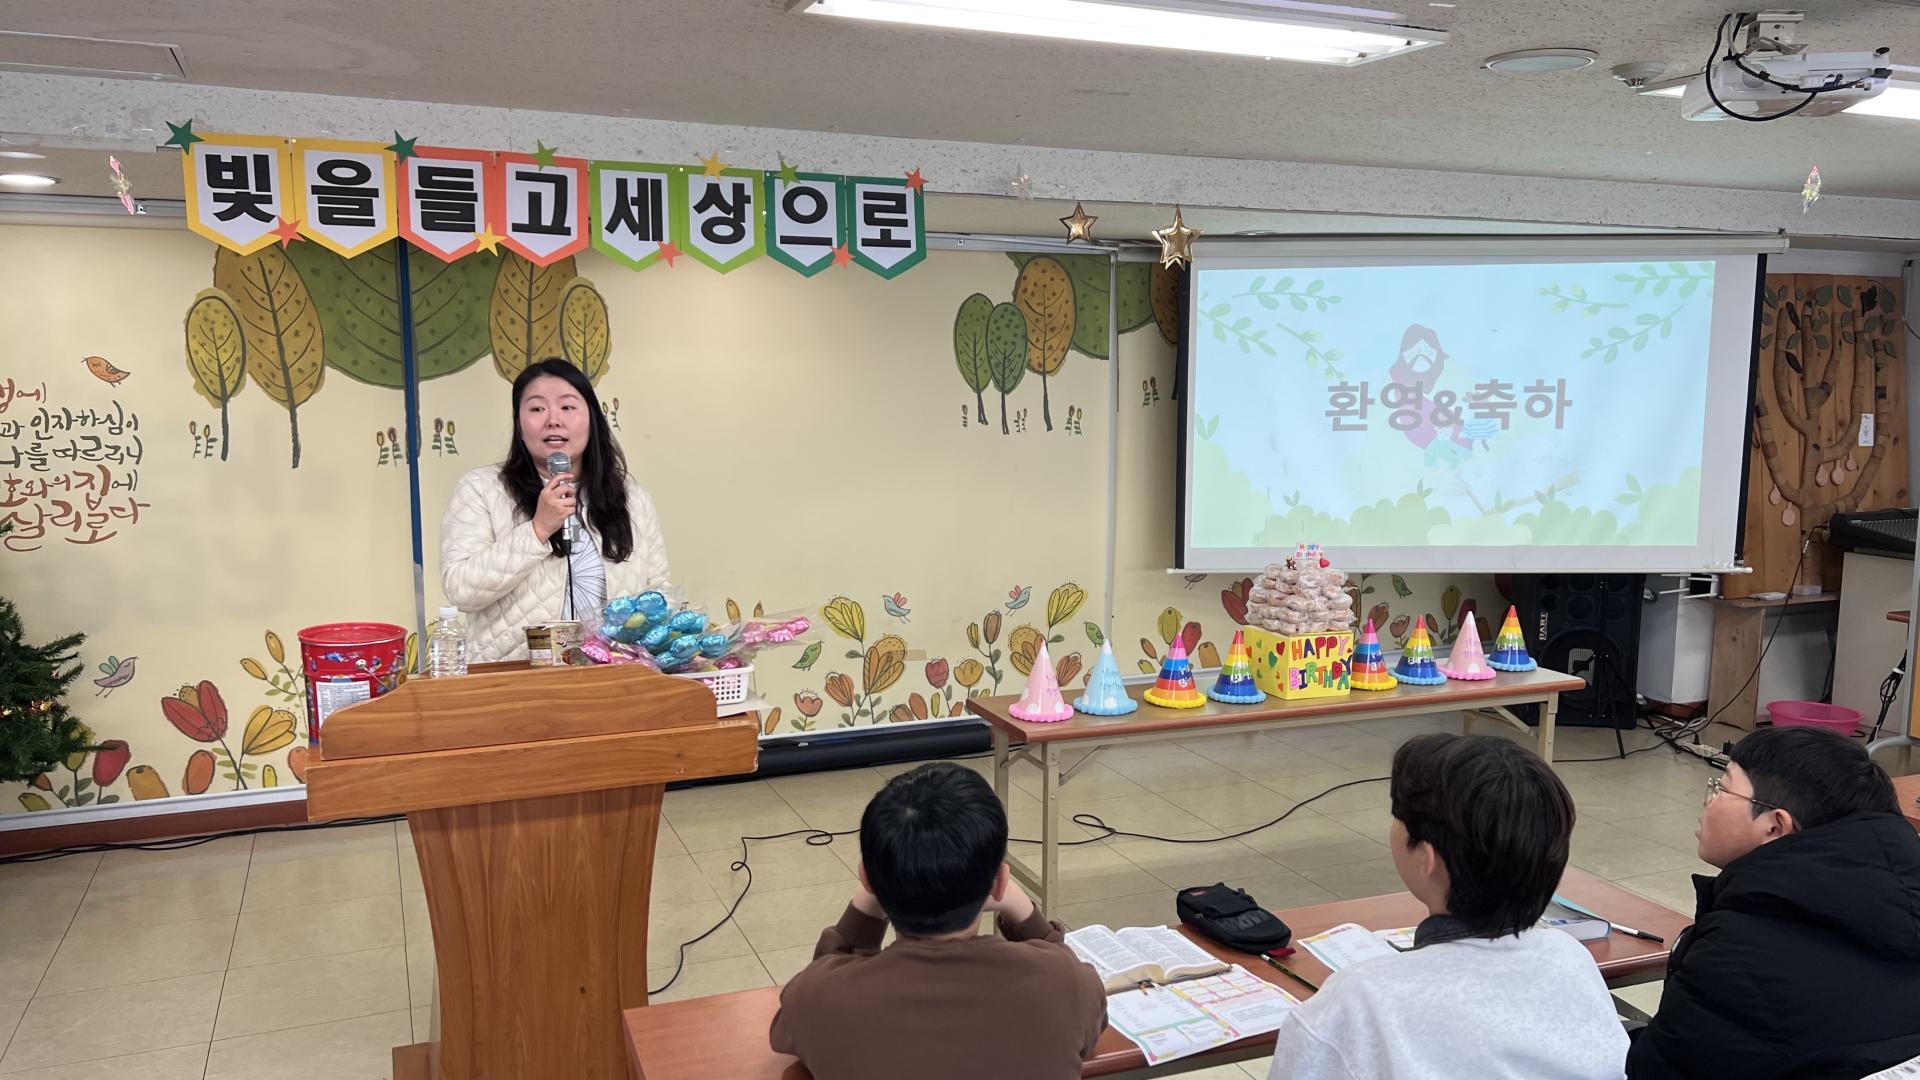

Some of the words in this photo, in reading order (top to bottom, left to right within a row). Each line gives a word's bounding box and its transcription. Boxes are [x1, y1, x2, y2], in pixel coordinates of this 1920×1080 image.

[204, 153, 380, 228] 빛을
[414, 165, 573, 237] 들고
[30, 400, 139, 440] 인자하심이
[1325, 378, 1574, 433] 환영&축하
[72, 463, 138, 511] 집에
[1291, 636, 1350, 661] HAPPY
